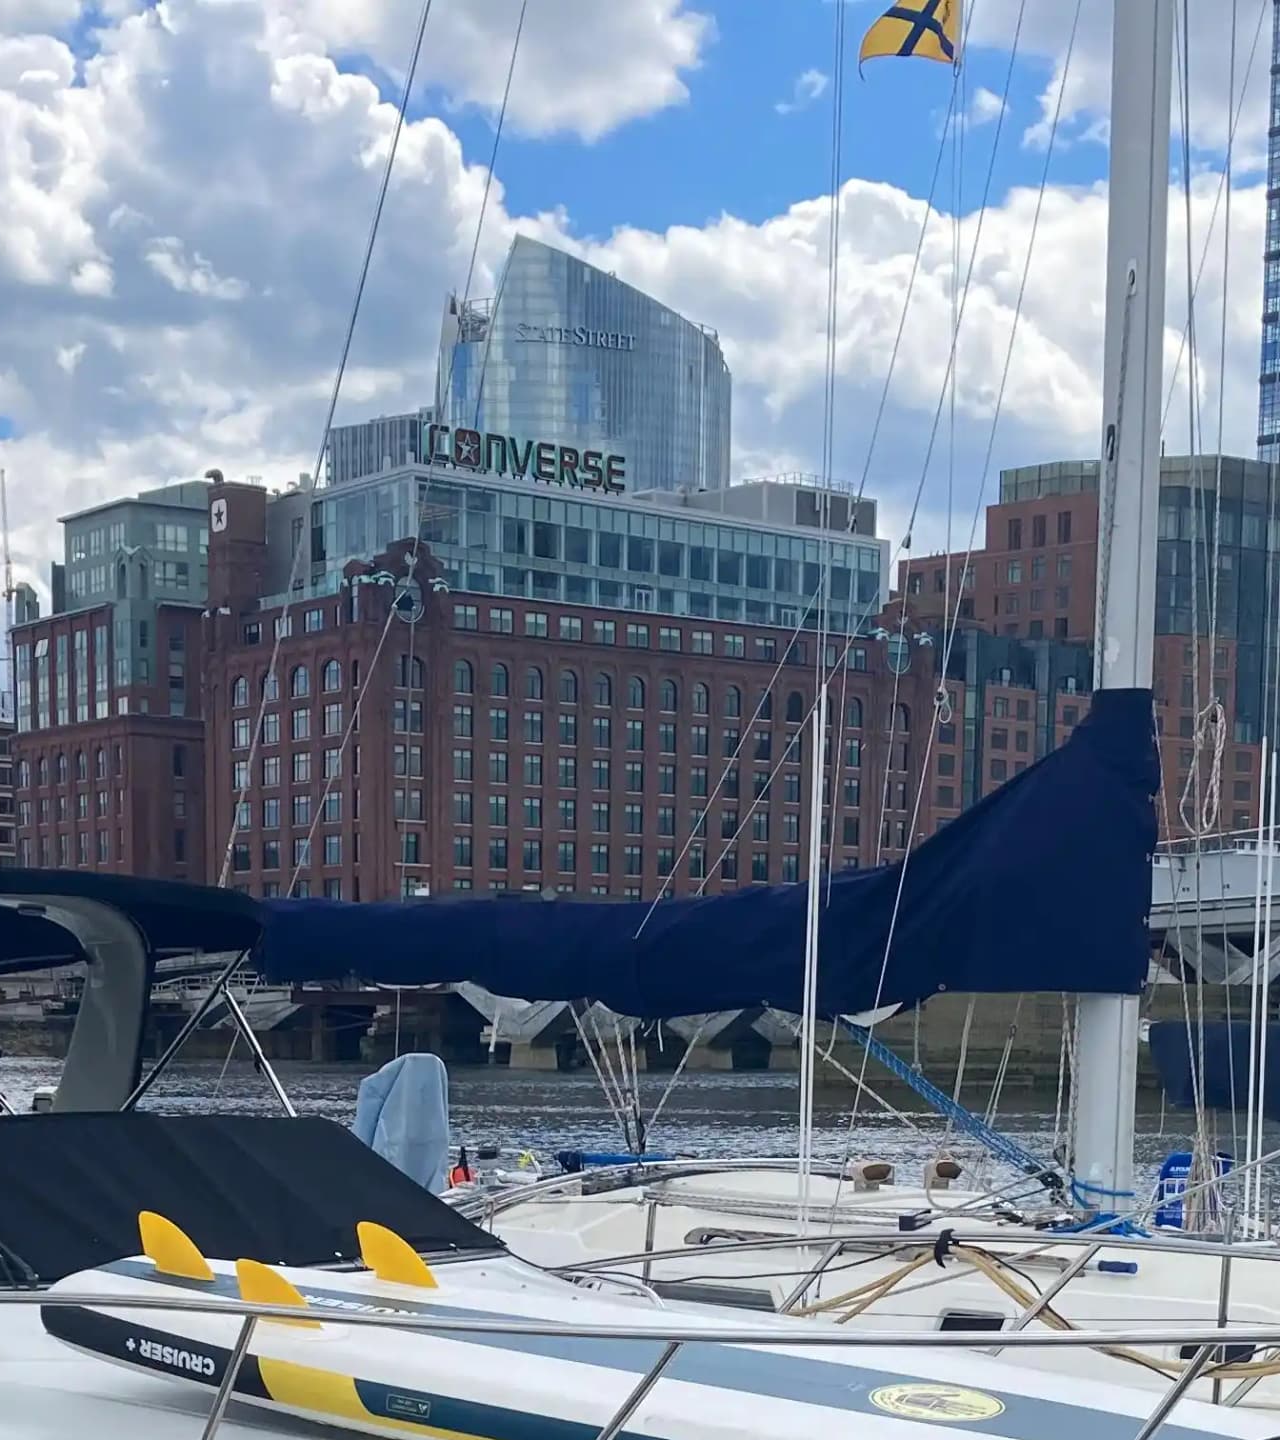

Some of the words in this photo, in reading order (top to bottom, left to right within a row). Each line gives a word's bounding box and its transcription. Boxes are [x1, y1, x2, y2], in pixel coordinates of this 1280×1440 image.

[574, 326, 634, 349] STREET
[424, 424, 626, 493] CONVERSE
[139, 1339, 215, 1376] CRUISER
